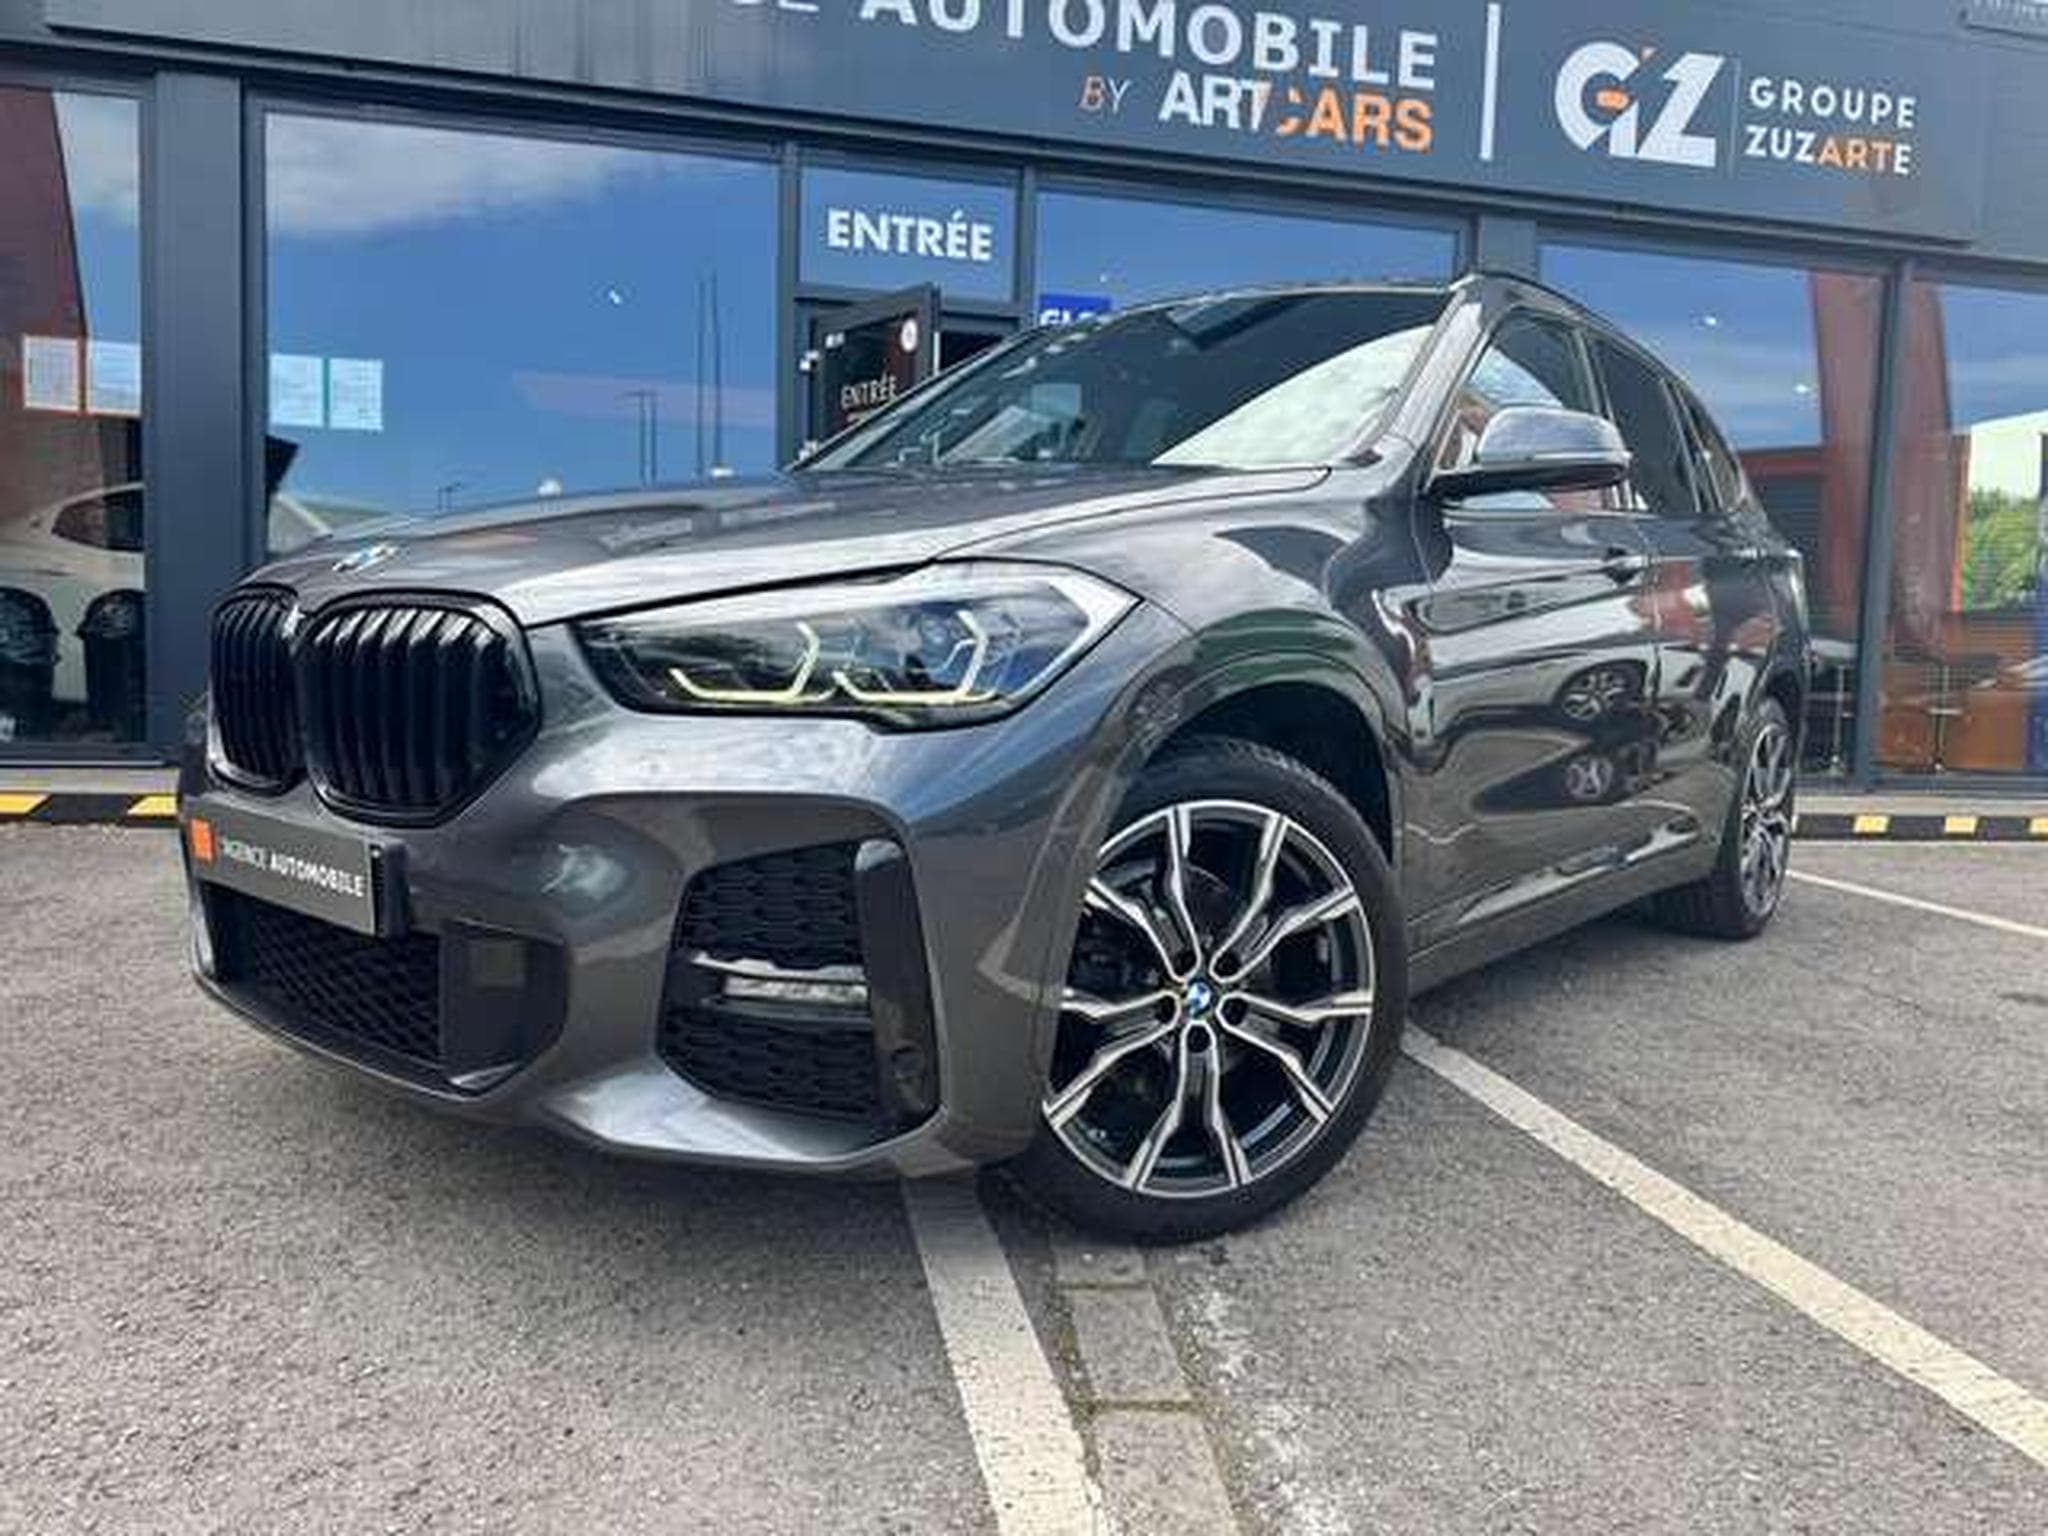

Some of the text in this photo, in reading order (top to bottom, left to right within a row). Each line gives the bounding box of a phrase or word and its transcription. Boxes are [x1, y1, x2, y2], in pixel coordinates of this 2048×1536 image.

[1079, 76, 1130, 114] BY
[1748, 76, 1915, 128] GROUPE
[1744, 125, 1912, 174] ZUZARTE
[828, 208, 992, 262] ENTRÉE
[270, 850, 364, 898] AUTOMOBILE
